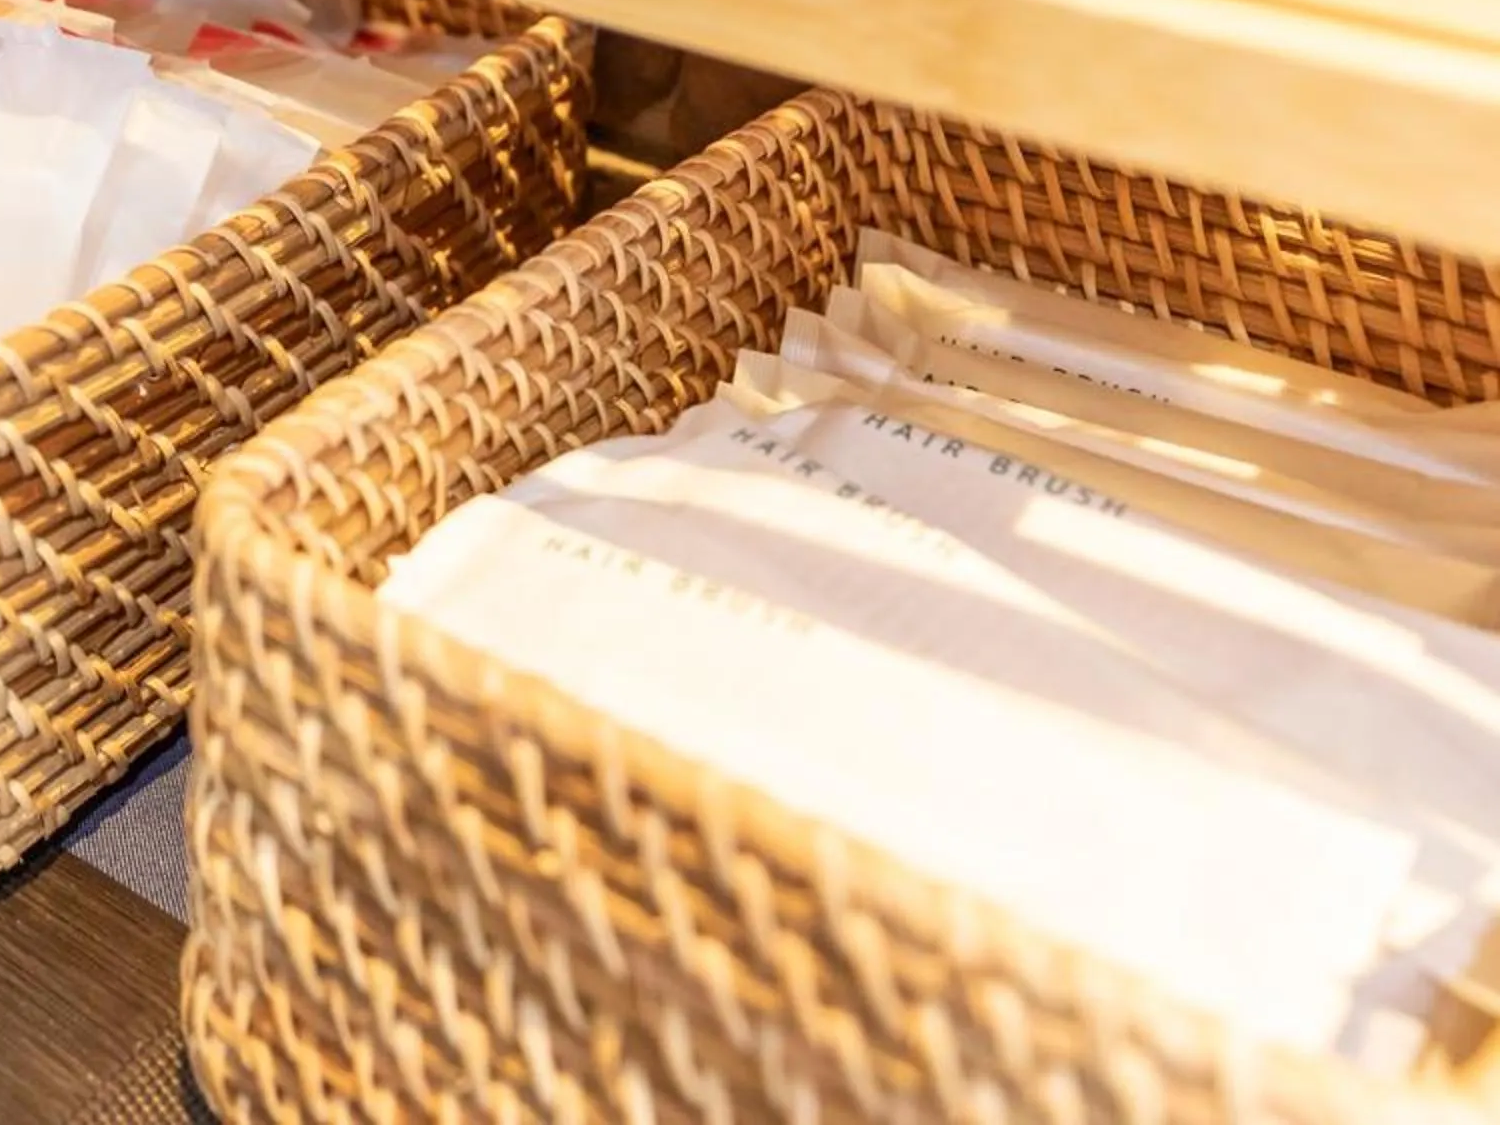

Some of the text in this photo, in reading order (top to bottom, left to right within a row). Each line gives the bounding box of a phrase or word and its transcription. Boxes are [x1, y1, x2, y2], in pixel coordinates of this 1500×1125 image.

[728, 426, 825, 477] HAIR
[861, 410, 1130, 518] HAIR BRUSH
[541, 535, 645, 577] HAIR
